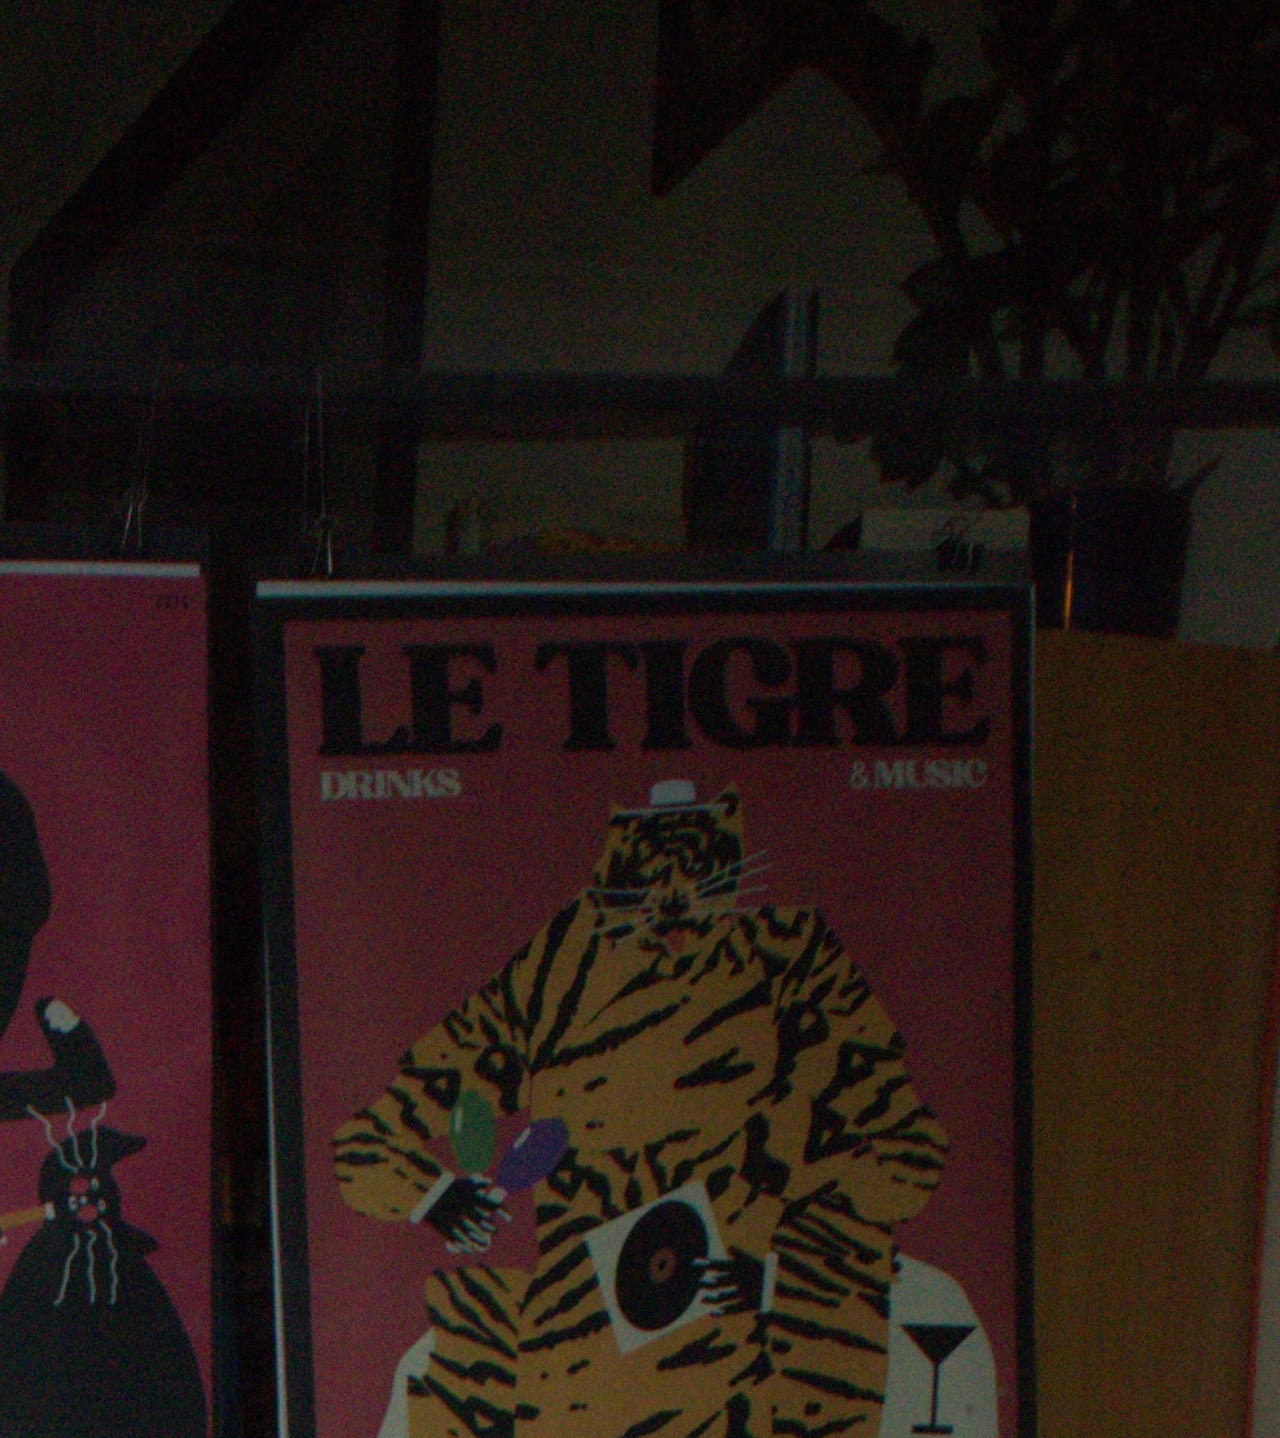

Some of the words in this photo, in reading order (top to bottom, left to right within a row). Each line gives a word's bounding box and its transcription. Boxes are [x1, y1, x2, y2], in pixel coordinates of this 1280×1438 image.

[313, 643, 502, 757] LE
[536, 633, 991, 753] TIGRE
[319, 769, 462, 801] DRINKS
[873, 758, 989, 790] MUSIC
